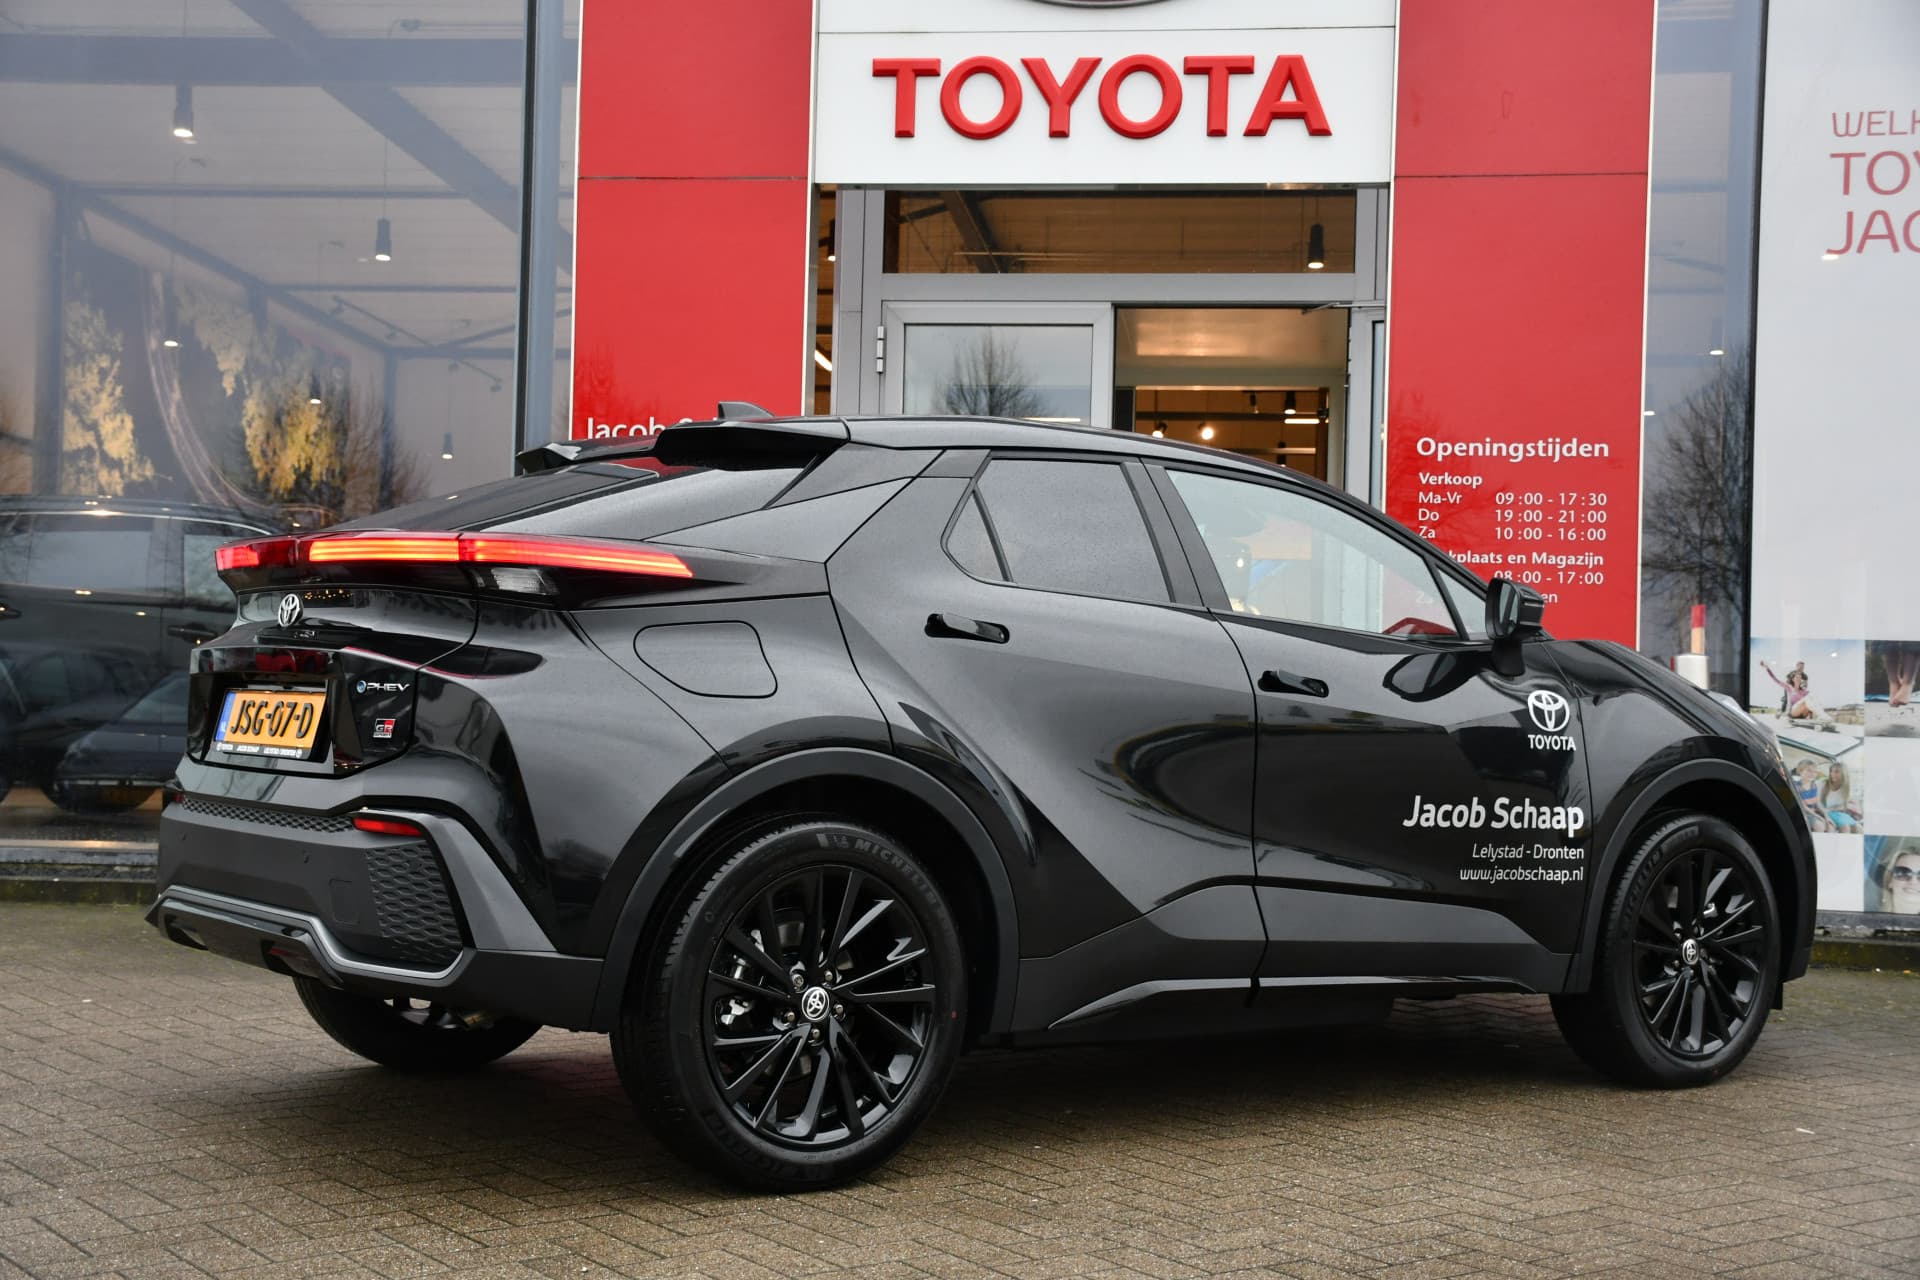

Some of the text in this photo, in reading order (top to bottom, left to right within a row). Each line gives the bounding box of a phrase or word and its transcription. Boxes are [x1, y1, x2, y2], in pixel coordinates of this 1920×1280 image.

[872, 54, 1332, 140] TOYOTA
[1830, 150, 1920, 196] TO
[1416, 437, 1609, 463] Openingstijden
[1419, 472, 1483, 488] Verkoop
[1418, 492, 1462, 504] Ma-Vr
[1418, 509, 1440, 521] Do
[1418, 526, 1436, 539] Za
[1507, 553, 1527, 564] en
[1531, 552, 1604, 569] Magazijn
[366, 682, 410, 692] PHEV
[229, 699, 315, 739] JSG-07-D
[1527, 734, 1577, 752] TOYOTA
[1402, 795, 1585, 838] Jacob Schaap
[1471, 843, 1524, 862] Lelystad
[1533, 844, 1585, 860] Dronten
[1459, 865, 1584, 885] www.jacobschaap.nl
